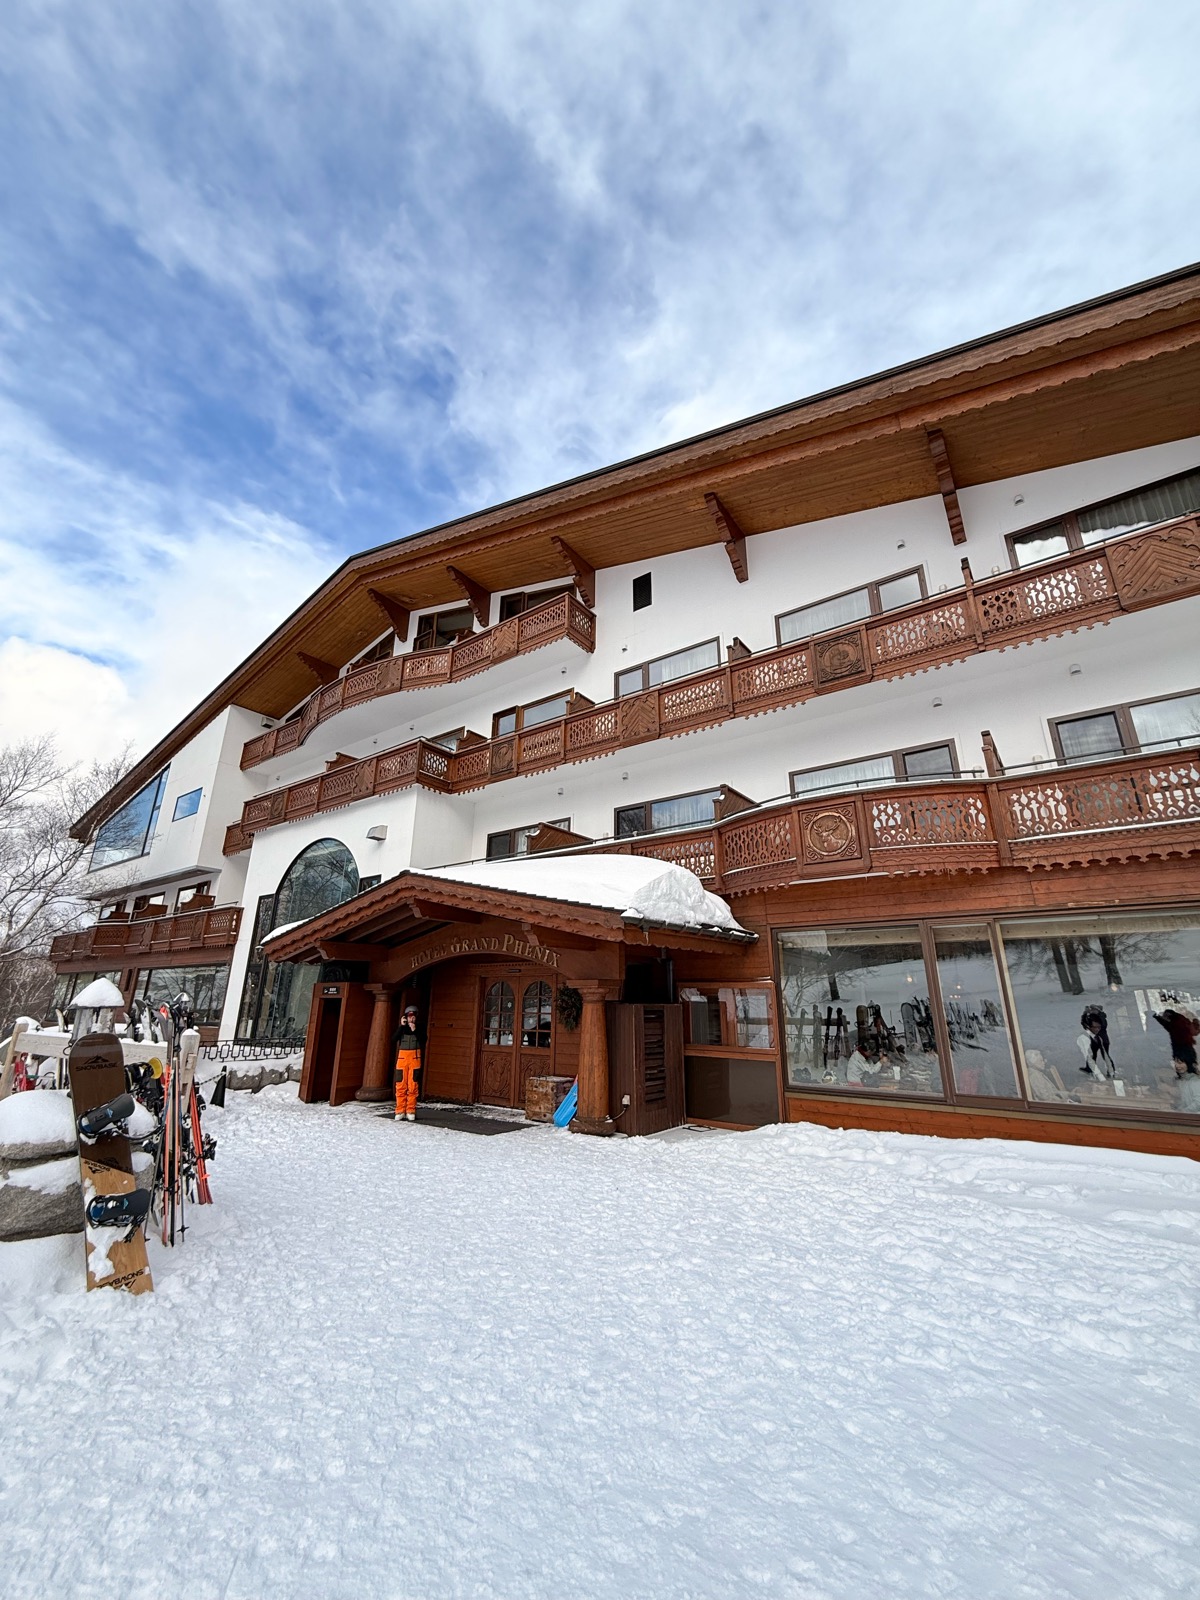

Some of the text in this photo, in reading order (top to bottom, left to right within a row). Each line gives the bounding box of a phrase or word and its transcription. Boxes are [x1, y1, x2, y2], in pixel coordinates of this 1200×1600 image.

[411, 933, 560, 968] HOTEL GRAND PHENIX
